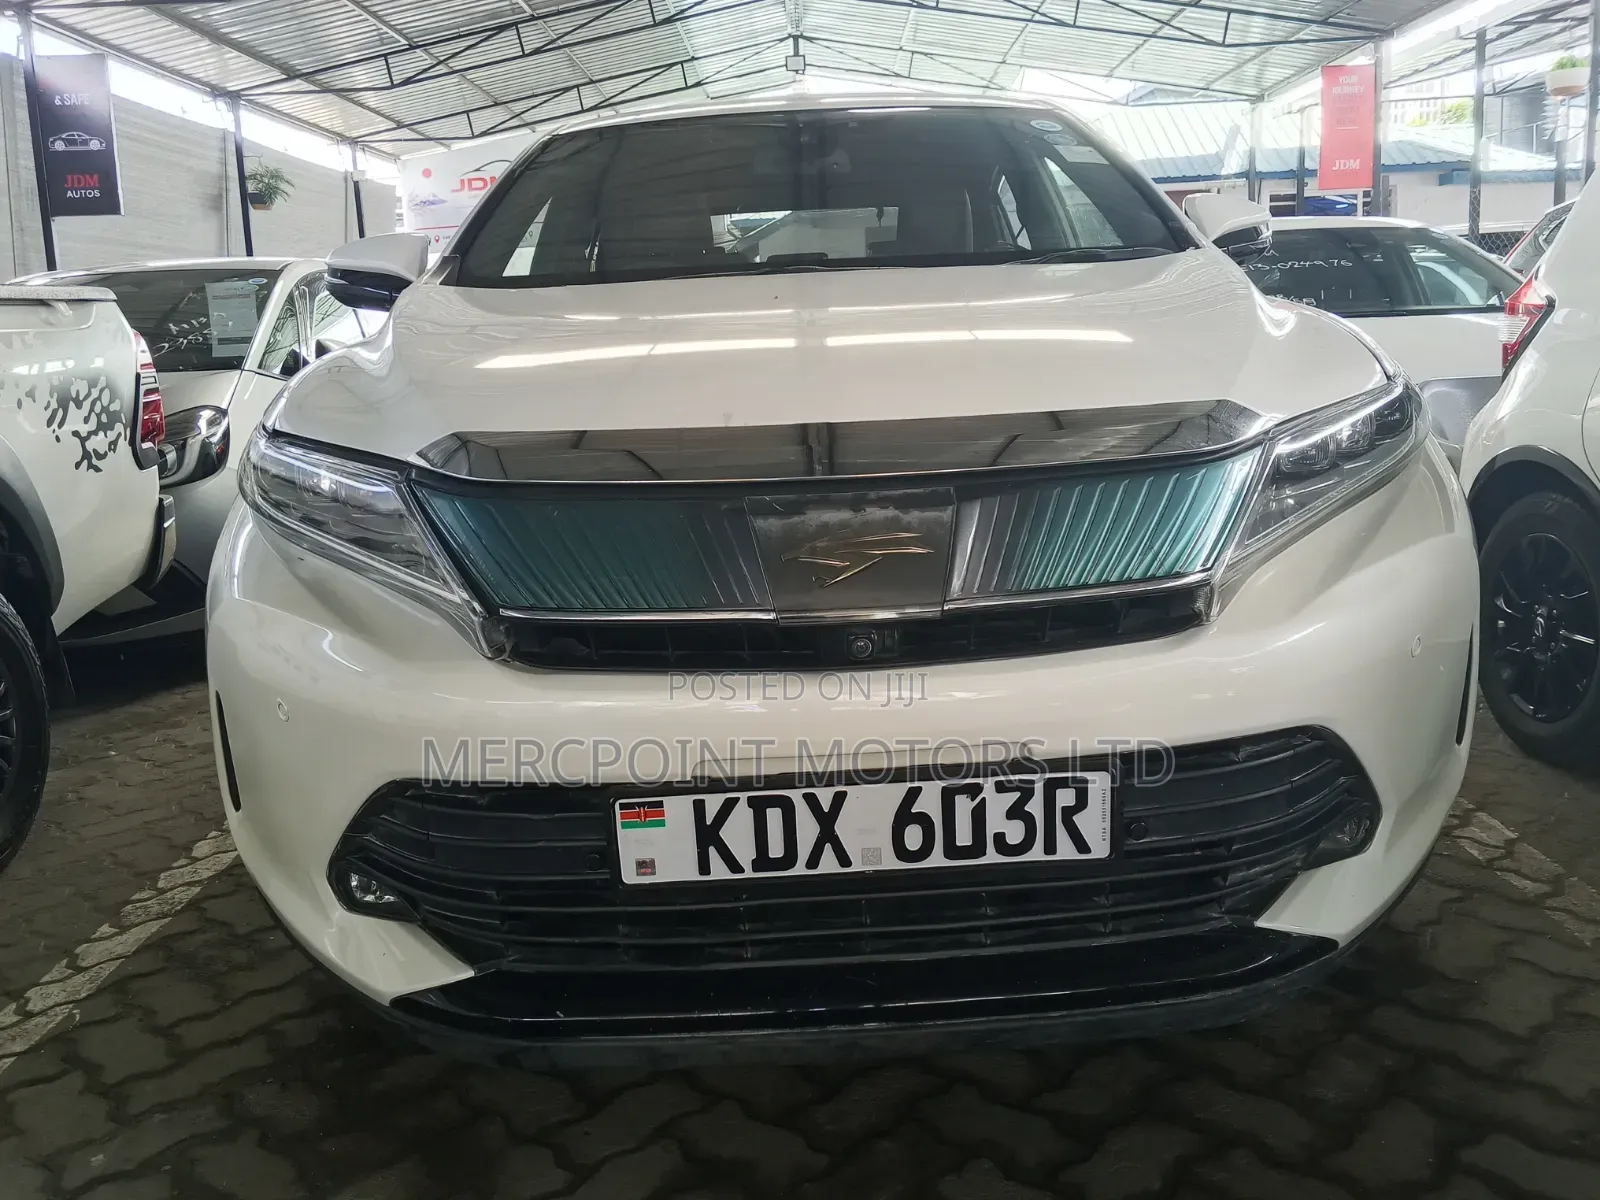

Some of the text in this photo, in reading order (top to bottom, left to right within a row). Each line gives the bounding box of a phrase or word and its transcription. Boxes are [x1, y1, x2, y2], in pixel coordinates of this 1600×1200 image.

[1332, 84, 1365, 95] JOURNEY
[54, 93, 89, 106] & SAFE
[1332, 159, 1361, 171] JDM
[64, 174, 99, 188] JDM
[66, 189, 101, 198] AUTOS
[692, 776, 1092, 876] KDX 603R
